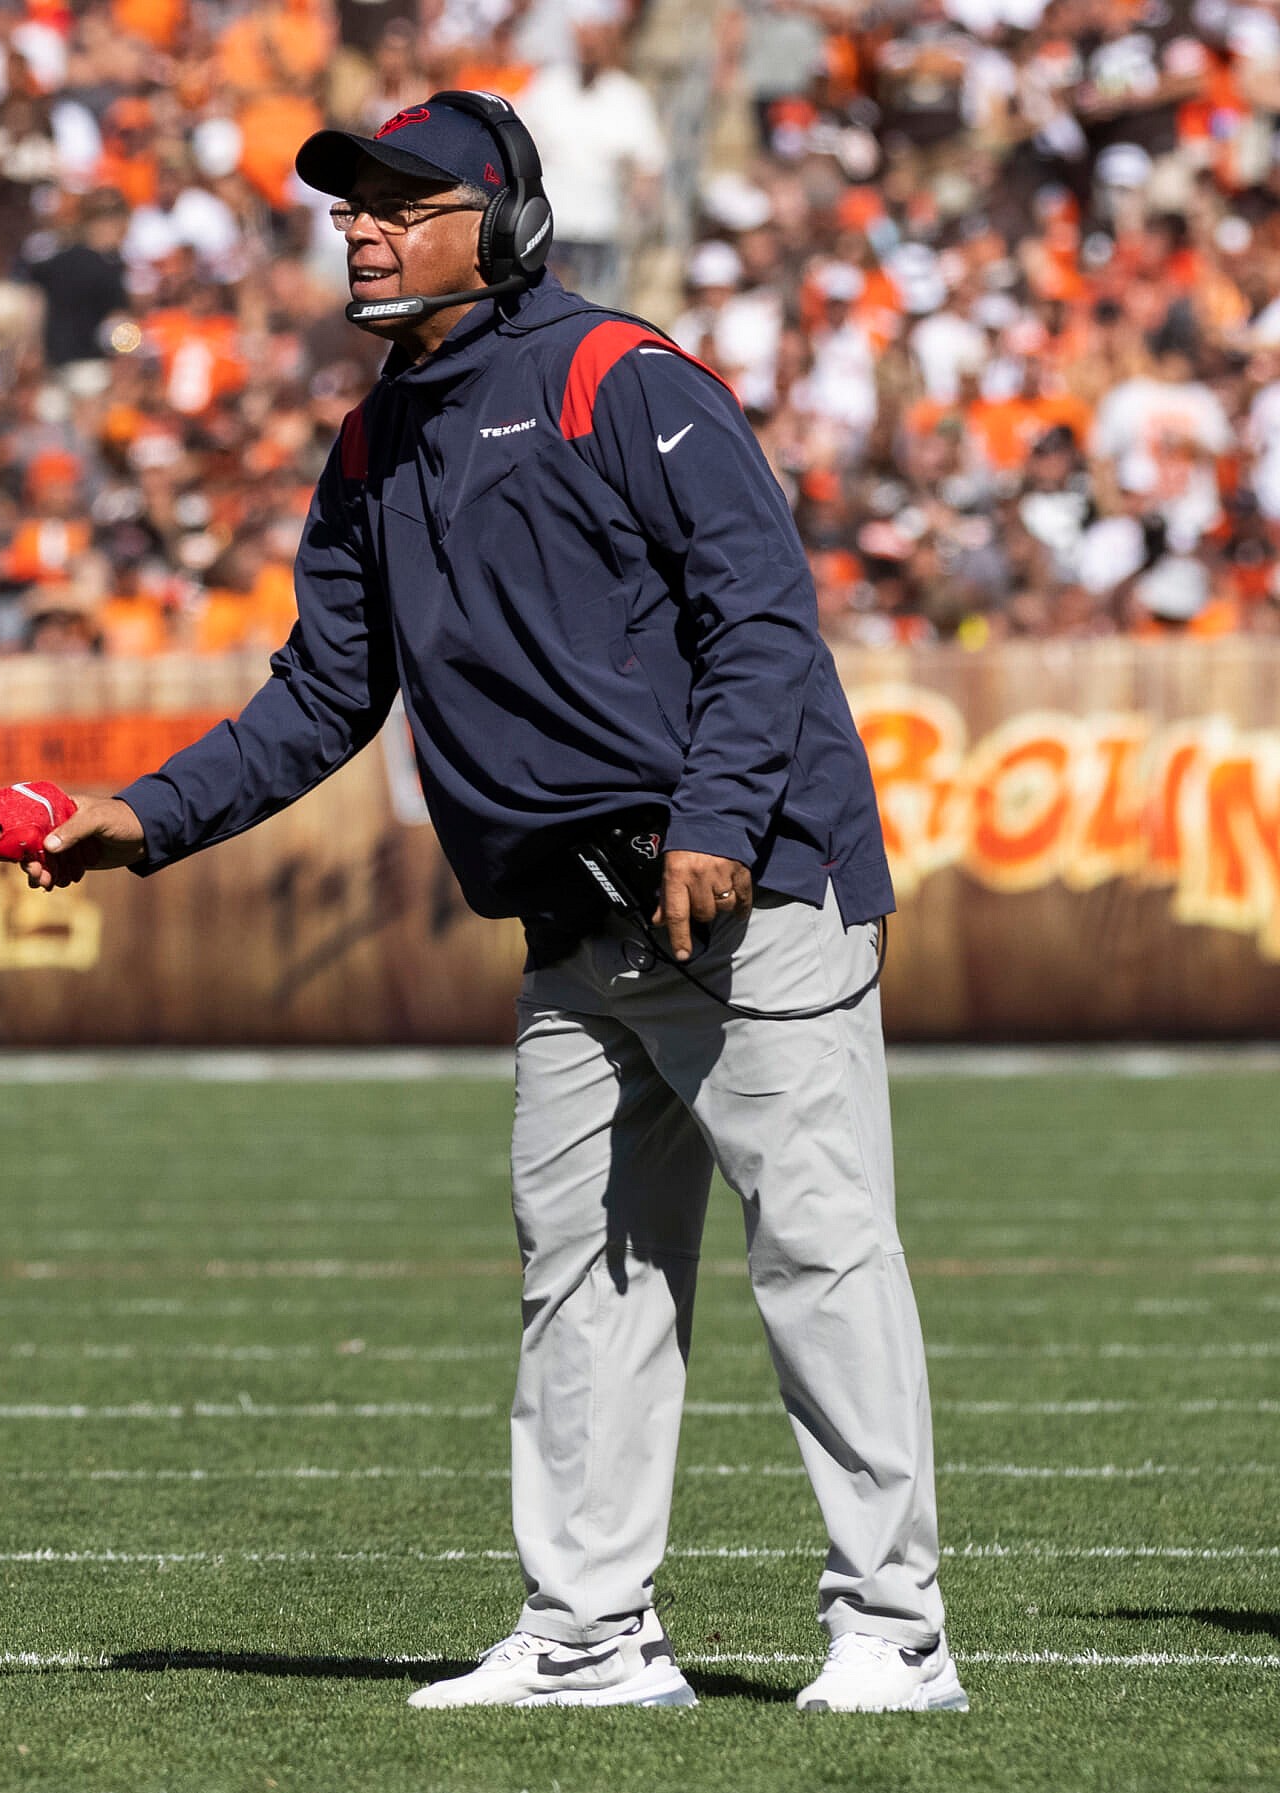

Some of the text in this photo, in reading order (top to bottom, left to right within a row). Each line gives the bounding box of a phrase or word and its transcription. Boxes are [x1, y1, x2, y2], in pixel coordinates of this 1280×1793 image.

[352, 300, 417, 318] BOSE
[479, 417, 537, 438] TEXANS
[577, 853, 628, 907] BOSE
